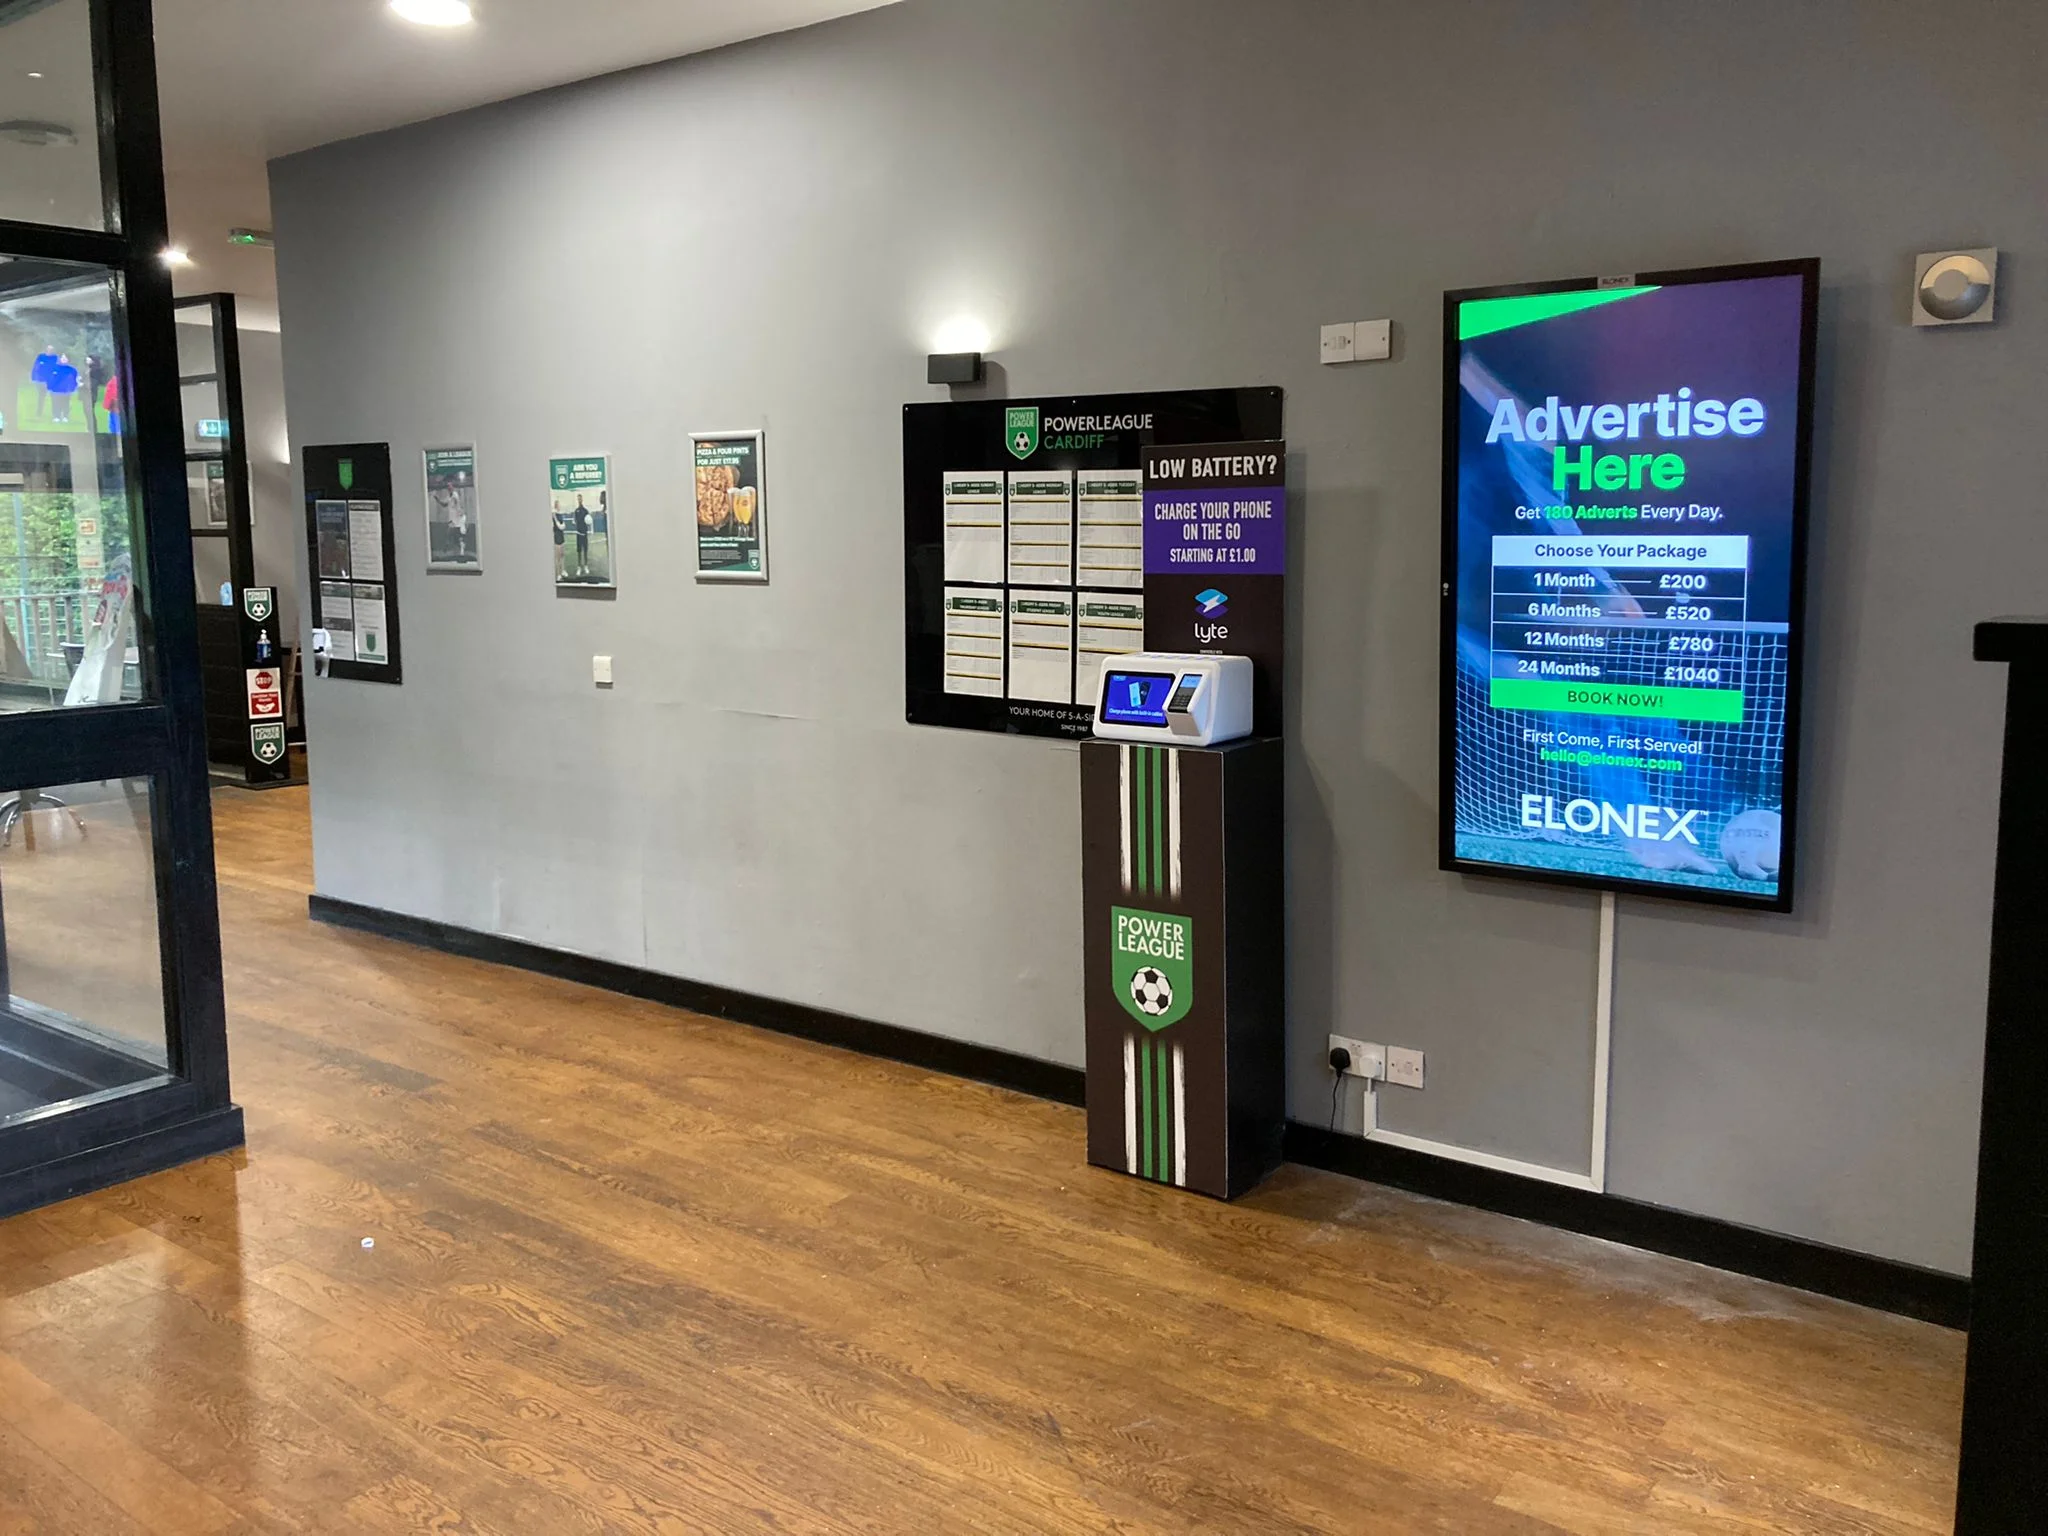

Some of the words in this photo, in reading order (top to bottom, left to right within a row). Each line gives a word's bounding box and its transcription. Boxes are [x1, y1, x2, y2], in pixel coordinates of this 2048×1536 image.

[1009, 411, 1034, 419] POWER
[1009, 419, 1034, 427] LEAGUE
[1044, 414, 1153, 432] POWERLEAGUE
[1485, 386, 1764, 443] Advertise
[1044, 434, 1104, 449] CARDIFF
[1149, 459, 1185, 479] LOW
[1191, 455, 1277, 478] BATTERY?
[1552, 445, 1685, 490] Here
[1154, 503, 1198, 520] CHARGE
[1200, 502, 1230, 520] YOUR
[1233, 501, 1272, 519] PHONE
[1515, 505, 1541, 520] Get
[1544, 505, 1573, 520] 180
[1575, 505, 1638, 520] Adverts
[1641, 505, 1685, 522] Every
[1688, 503, 1724, 521] Day.
[1183, 523, 1198, 540] ON
[1201, 523, 1222, 540] THE
[1225, 523, 1241, 540] GO
[1170, 548, 1213, 563] STARTING
[1216, 548, 1228, 563] AT
[1229, 548, 1256, 563] £1.00
[1534, 544, 1594, 557] Choose
[1597, 544, 1634, 558] Your
[1636, 544, 1707, 561] Package
[1533, 573, 1541, 587] 1
[1543, 573, 1596, 588] Month
[1659, 574, 1706, 589] £200
[1527, 603, 1539, 616] 6
[1541, 603, 1601, 618] Months
[1665, 606, 1711, 621] £520
[1194, 623, 1229, 643] lyte
[1524, 632, 1542, 645] 12
[1544, 632, 1605, 648] Months
[1668, 636, 1714, 652] £780
[1518, 660, 1538, 674] 24
[1541, 661, 1600, 677] Months
[1664, 667, 1720, 683] £1040
[1568, 690, 1613, 705] BOOK
[1617, 693, 1664, 708] NOW!
[1009, 706, 1031, 716] YOUR
[1031, 709, 1055, 719] HOME
[1056, 710, 1067, 719] OF
[1523, 729, 1555, 743] First
[1557, 731, 1604, 749] Come,
[1607, 735, 1641, 750] First
[1643, 738, 1703, 755] Served!
[1540, 748, 1684, 771] hello@elonex.com
[1521, 794, 1700, 845] ELONEX
[1118, 915, 1185, 942] POWER
[1118, 933, 1185, 960] LEAGUE
